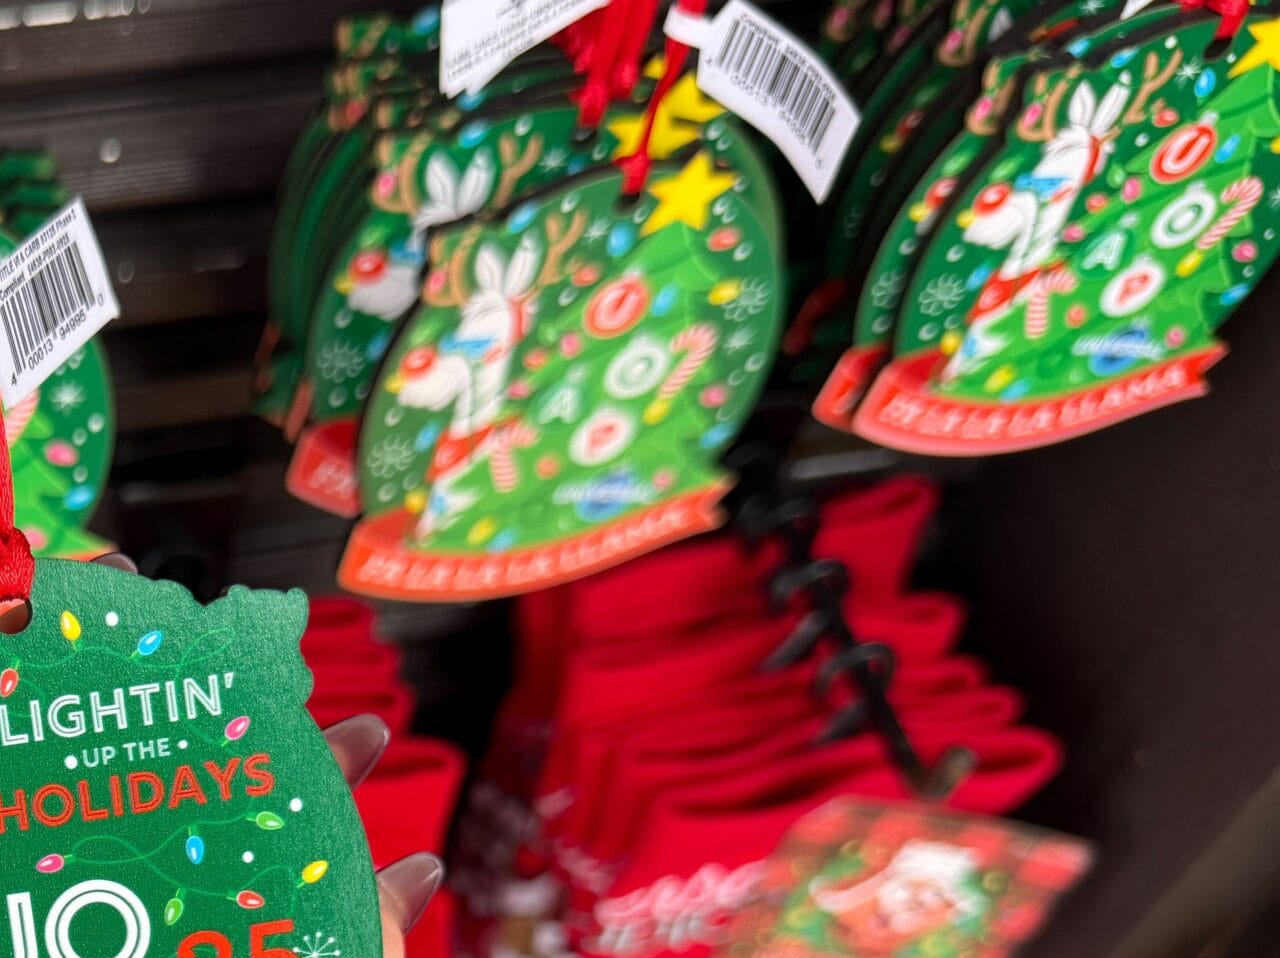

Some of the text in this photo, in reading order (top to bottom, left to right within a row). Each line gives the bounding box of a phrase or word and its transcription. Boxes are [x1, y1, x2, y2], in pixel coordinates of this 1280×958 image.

[0, 261, 15, 283] TITLE
[24, 240, 41, 260] CARB
[0, 273, 25, 302] Compliant
[11, 294, 104, 387] 4 00013 94995 0
[82, 738, 171, 768] UP THE
